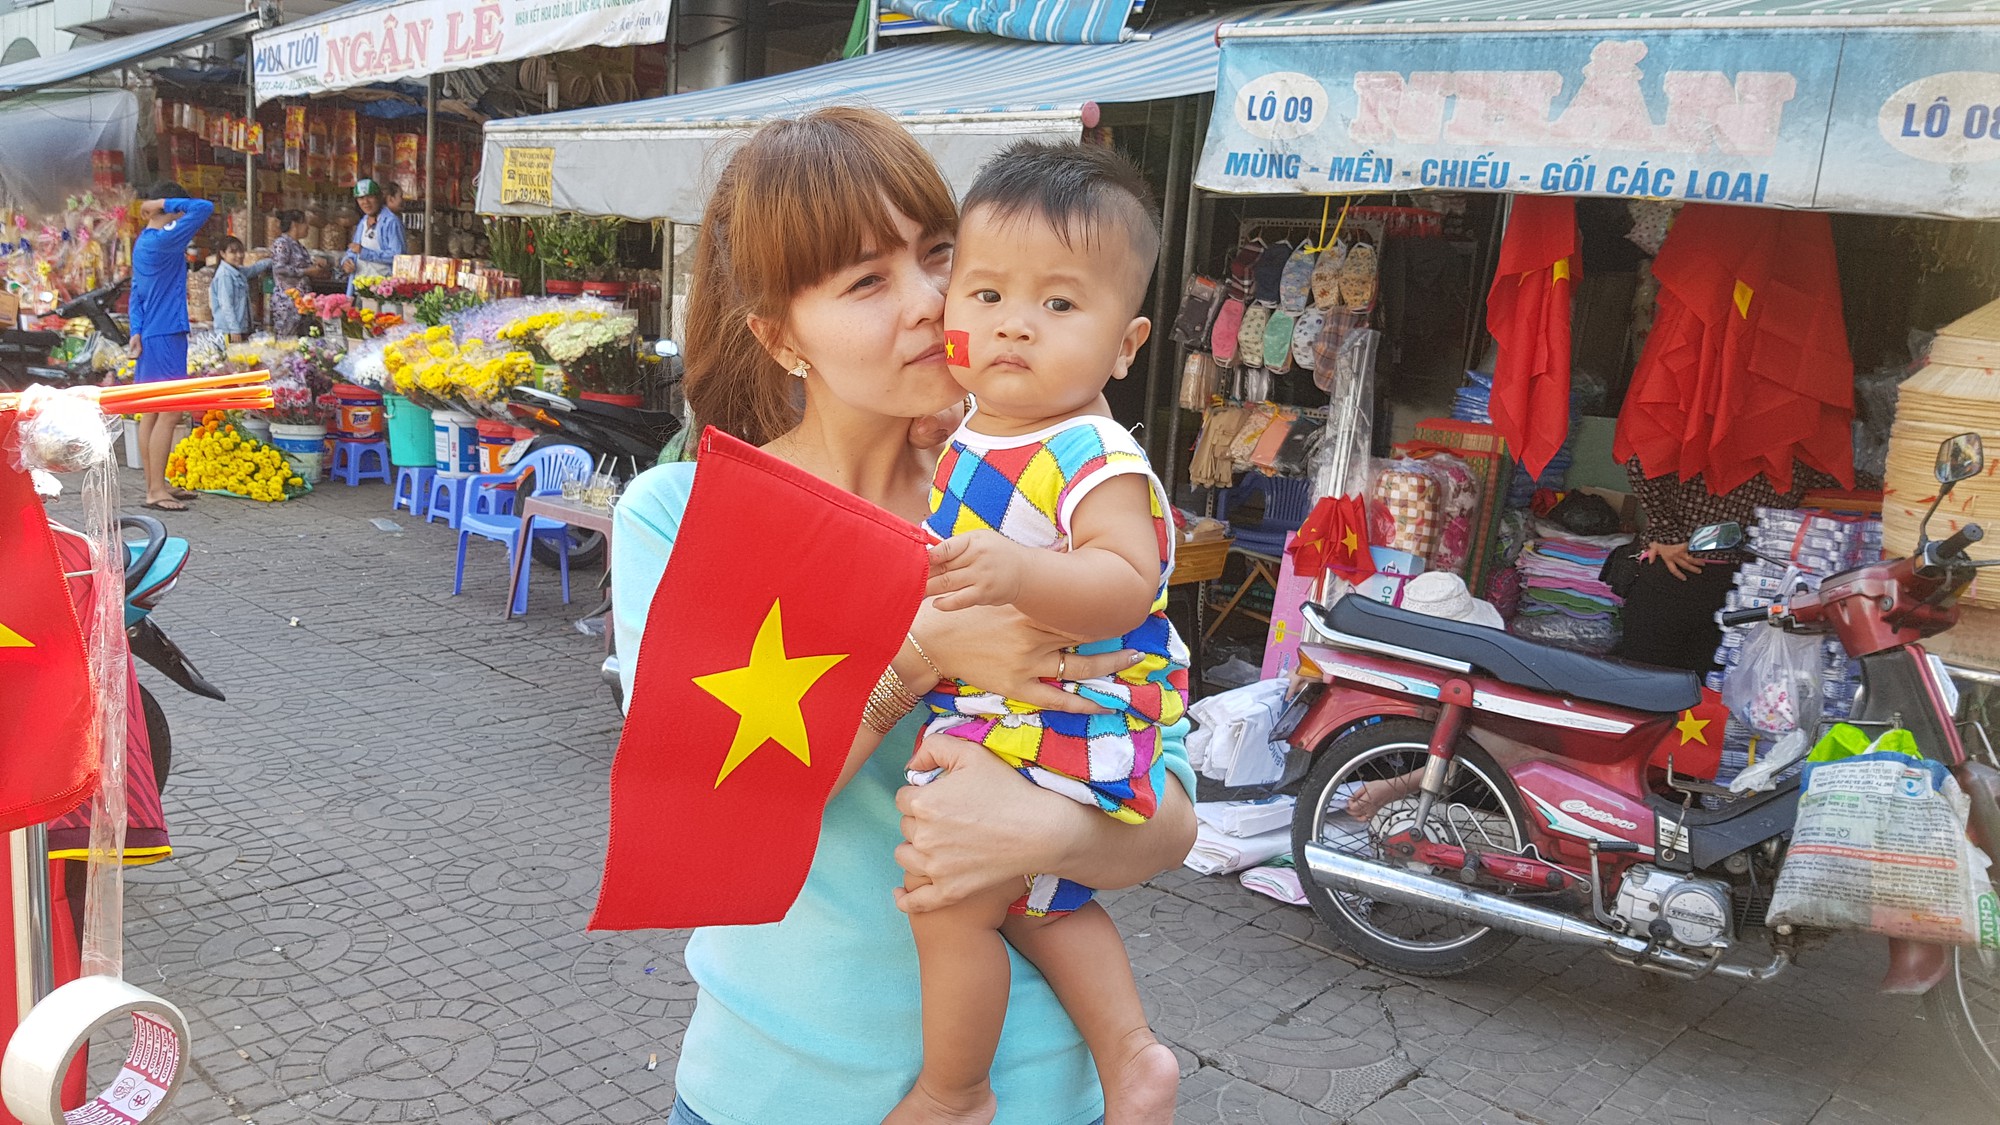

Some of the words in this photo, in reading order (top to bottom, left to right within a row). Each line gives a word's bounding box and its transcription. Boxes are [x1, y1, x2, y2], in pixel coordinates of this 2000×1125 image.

[1247, 91, 1277, 122] LÔ
[1283, 96, 1314, 124] 09
[1900, 96, 1950, 138] LÔ
[1224, 147, 1301, 180] MÙNG
[1328, 149, 1393, 184] MỀN
[1420, 152, 1511, 189] CHIẾU
[1540, 155, 1596, 192] GỐI
[1605, 161, 1675, 198] CÁC
